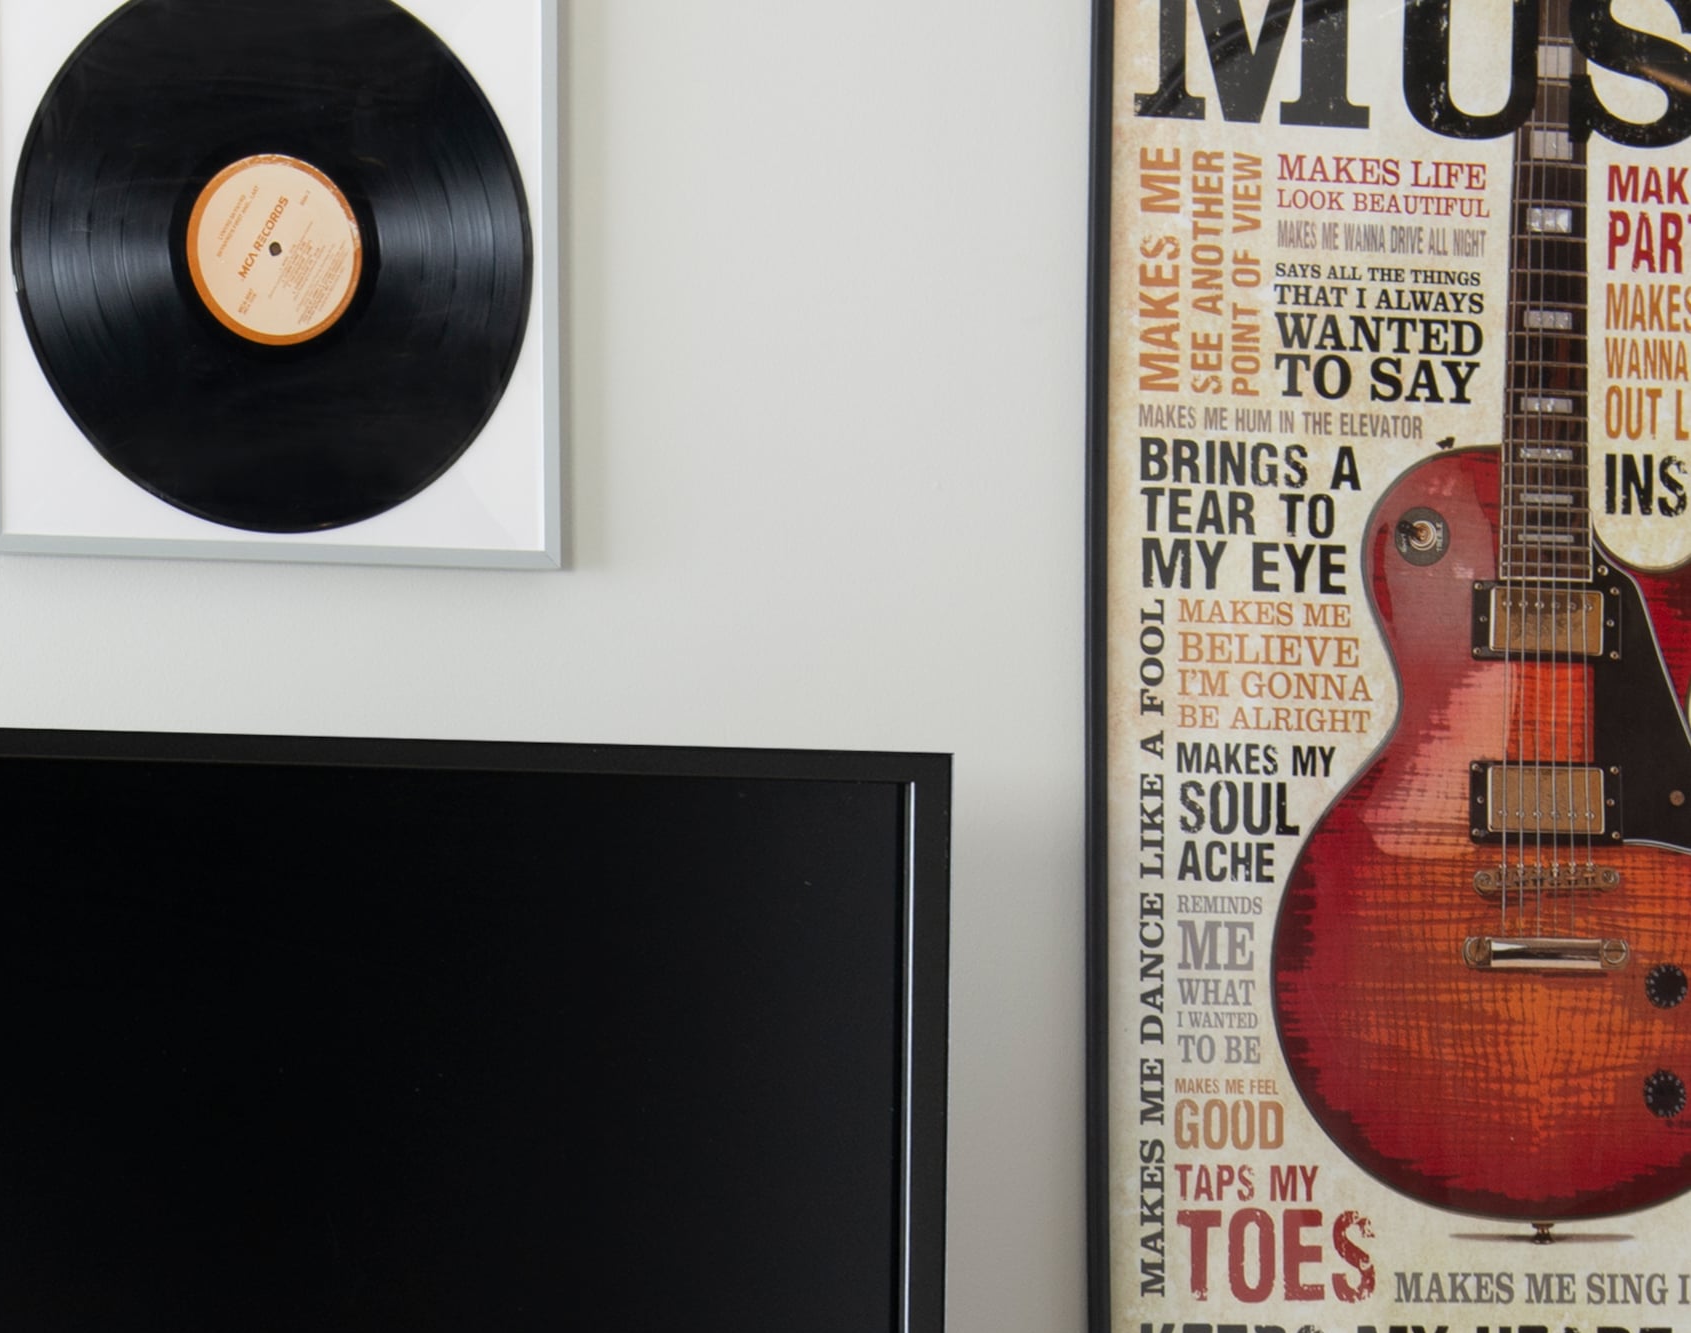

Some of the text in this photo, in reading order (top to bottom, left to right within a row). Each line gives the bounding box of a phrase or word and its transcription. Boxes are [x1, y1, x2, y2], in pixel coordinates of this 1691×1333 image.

[1278, 154, 1486, 190] MAKES LIFE
[1277, 188, 1490, 218] LOOK BEAUTIFUL
[238, 249, 259, 281] MCA
[253, 196, 289, 252] RECORDS
[1278, 220, 1486, 257] MAKES ME WANNA DRIVE ALL NIGHT
[1608, 210, 1691, 273] PAR
[1139, 147, 1181, 392] MAKES ME
[1191, 150, 1224, 394] SEE ANOTHER
[1231, 152, 1262, 396] POINT OF VIEW
[1276, 262, 1480, 286] SAYS ALL THE THINGS
[1274, 284, 1484, 314] THAT I ALWAYS
[1275, 312, 1483, 356] WANTED
[1605, 337, 1689, 381] WANNA
[1275, 354, 1480, 404] TO SAY
[1139, 404, 1422, 439] MAKES ME HUM IN THE ELEVATOR
[1605, 385, 1662, 440] OUT
[1140, 437, 1361, 490] BRINGS A
[1140, 487, 1335, 539] TEAR TO
[1142, 538, 1346, 595] MY EYE
[1178, 598, 1351, 628] MAKES ME
[1179, 631, 1359, 668] BELIEVE
[1178, 669, 1373, 701] I'M GONNA
[1178, 704, 1371, 734] BE ALRIGHT
[1177, 742, 1335, 777] MAKES MY
[1180, 781, 1300, 836] SOUL
[1178, 841, 1274, 883] ACHE
[1177, 895, 1262, 915] REMINDS
[1139, 599, 1165, 1297] MAKES ME DANCE LIKE A FOOL
[1177, 920, 1254, 971] ME
[1177, 978, 1255, 1006] WHAT
[1177, 1011, 1258, 1029] I WANTED
[1178, 1035, 1261, 1064] TO BE
[1175, 1078, 1279, 1095] MAKES ME FEEL
[1174, 1099, 1284, 1150] GOOD
[1174, 1164, 1319, 1201] TAPS MY
[1177, 1207, 1375, 1303] TOES
[1394, 1272, 1514, 1304] MAKES
[1525, 1273, 1576, 1304] ME
[1587, 1273, 1668, 1305] SING
